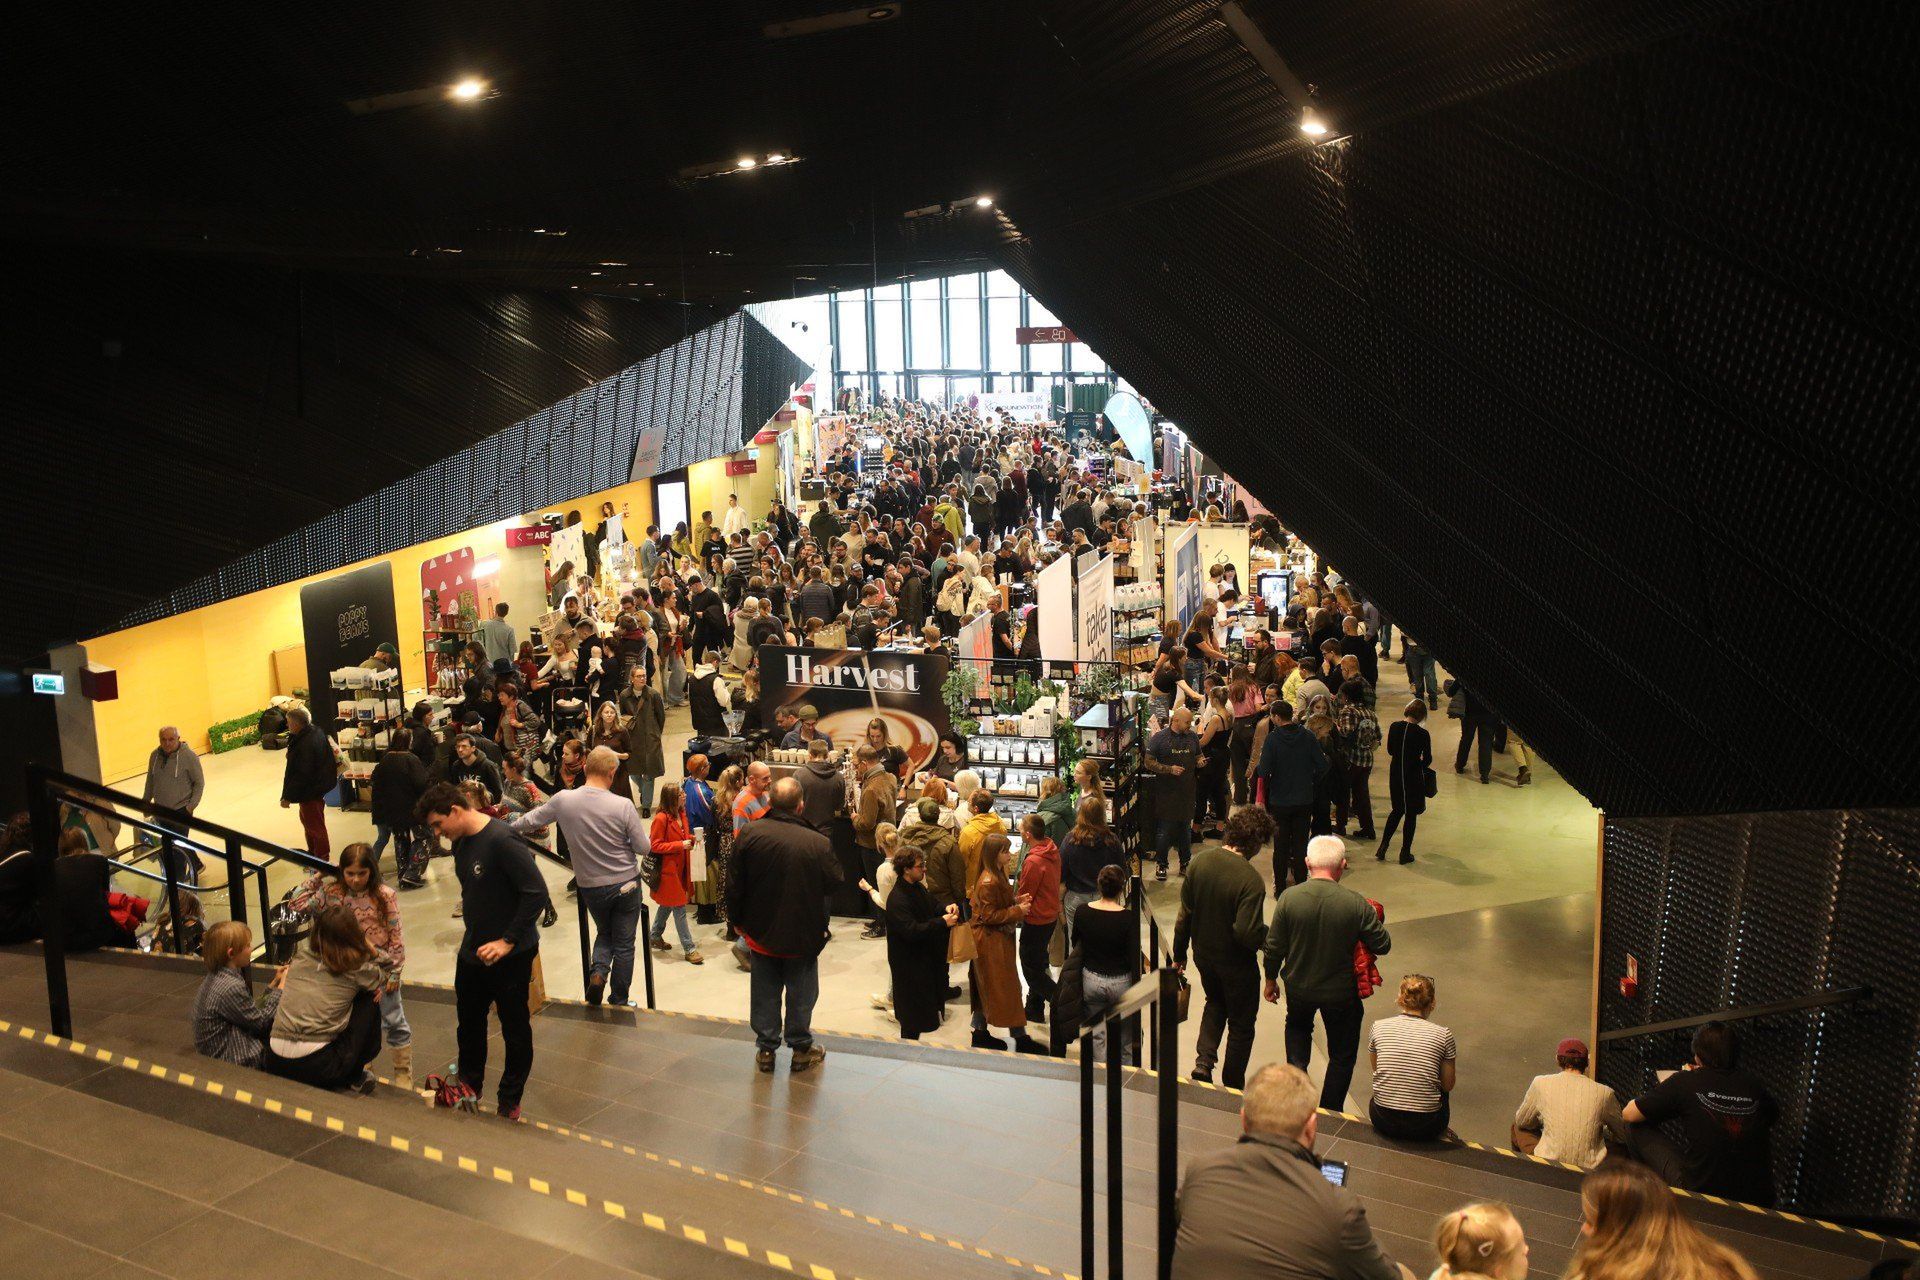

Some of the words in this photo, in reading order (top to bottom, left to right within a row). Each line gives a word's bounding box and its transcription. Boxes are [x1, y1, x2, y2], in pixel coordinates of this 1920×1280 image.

[534, 530, 550, 540] ABC
[1085, 600, 1107, 647] take
[785, 653, 921, 692] Harvest
